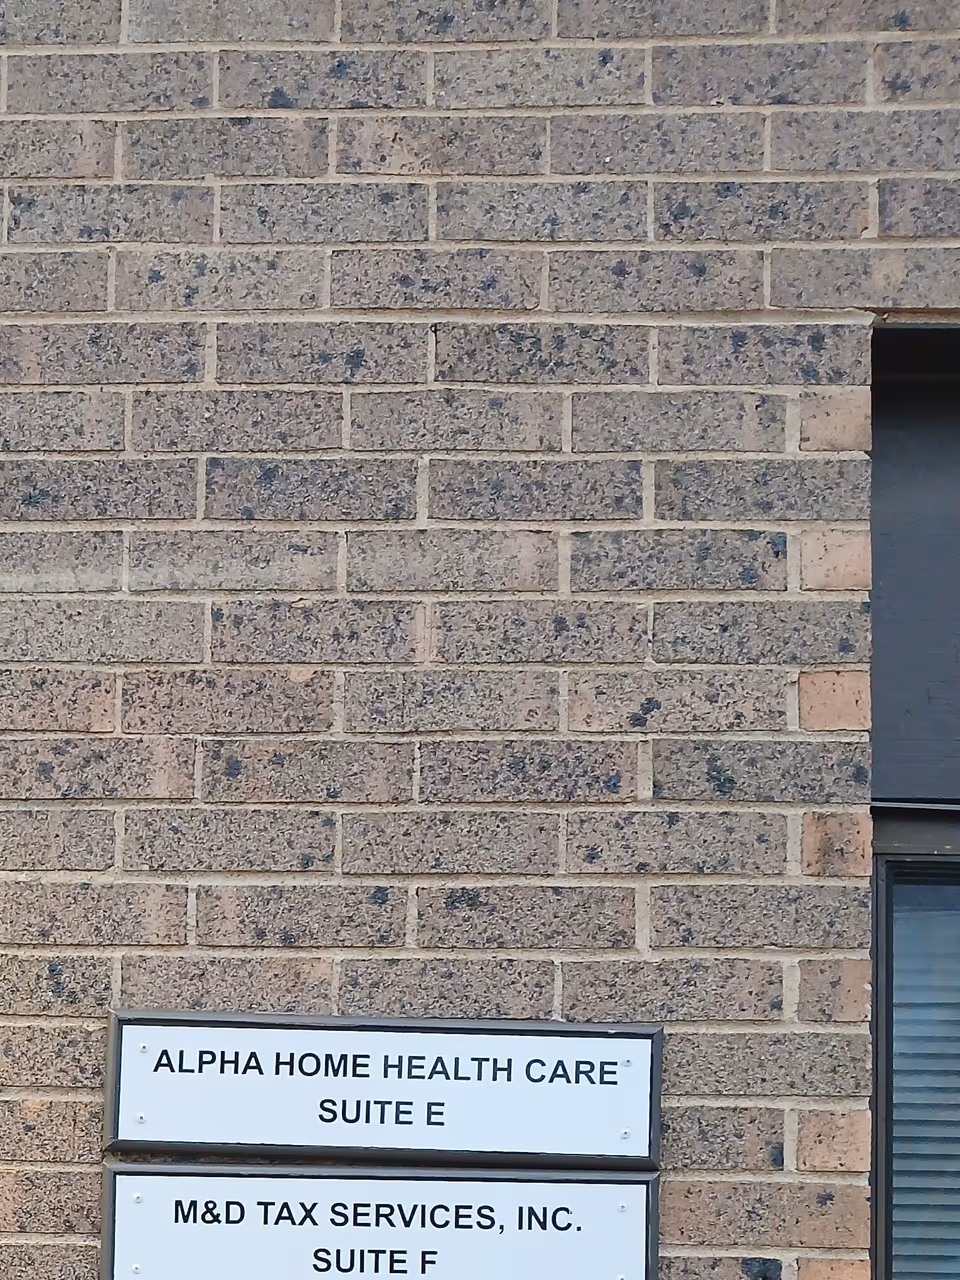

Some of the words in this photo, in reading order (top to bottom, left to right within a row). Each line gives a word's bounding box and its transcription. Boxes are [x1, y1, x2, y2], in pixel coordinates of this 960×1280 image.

[152, 1049, 265, 1076] ALPHA
[274, 1051, 371, 1078] HOME
[383, 1054, 513, 1083] HEALTH
[525, 1058, 618, 1086] CARE
[318, 1098, 414, 1126] SUITE
[426, 1101, 446, 1127] E
[174, 1199, 246, 1225] M&D
[256, 1200, 319, 1227] TAX
[329, 1202, 505, 1235] SERVICES,
[517, 1205, 582, 1232] INC.
[312, 1248, 408, 1275] SUITE
[420, 1250, 438, 1275] F
